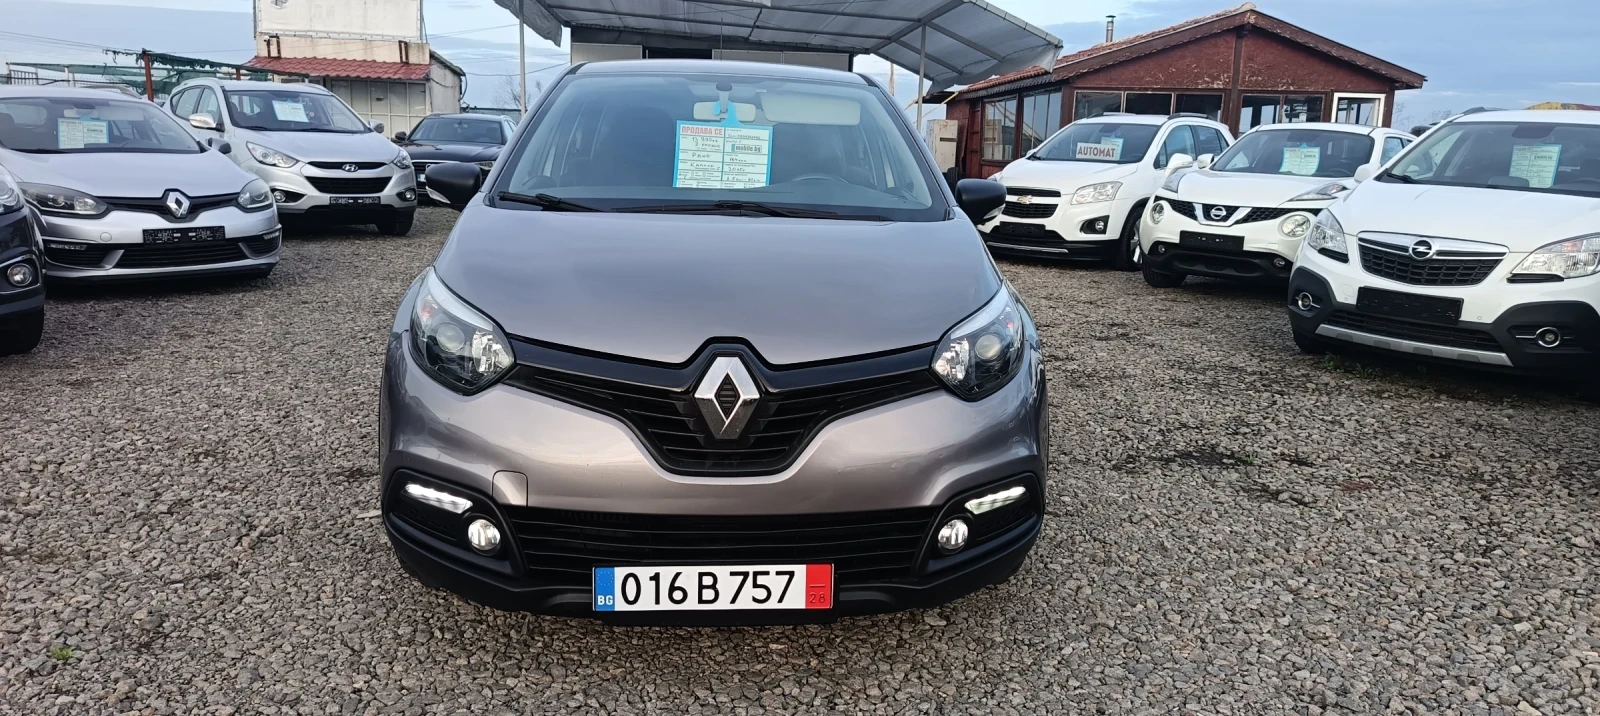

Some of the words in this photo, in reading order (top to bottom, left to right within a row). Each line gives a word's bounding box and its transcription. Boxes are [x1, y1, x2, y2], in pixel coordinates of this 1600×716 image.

[682, 126, 712, 135] ПРОДАВА
[1078, 146, 1116, 158] AUTOMAT
[597, 595, 614, 606] BG
[620, 570, 796, 606] 016B757
[809, 591, 826, 604] 28
